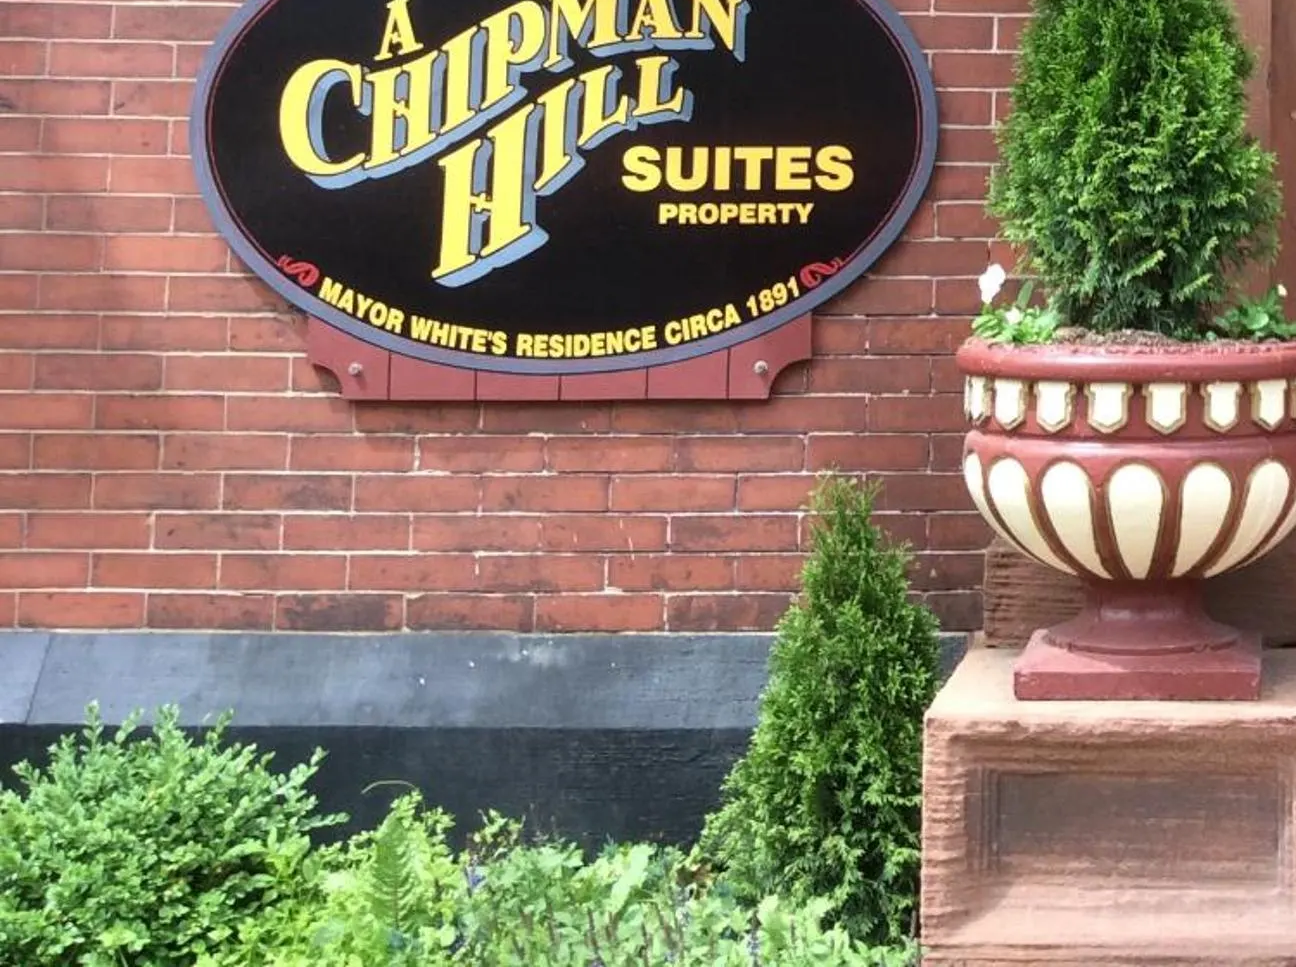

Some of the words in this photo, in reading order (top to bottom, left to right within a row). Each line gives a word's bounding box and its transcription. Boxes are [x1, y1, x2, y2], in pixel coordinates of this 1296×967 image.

[431, 56, 687, 282] HILL
[621, 144, 854, 192] SUITES
[658, 202, 815, 224] PROPERTY
[318, 277, 405, 333] MAYOR
[410, 315, 508, 356] WHITE'S
[516, 326, 657, 357] RESIDENCE
[664, 303, 742, 345] CIRCA
[746, 275, 800, 317] 1891
